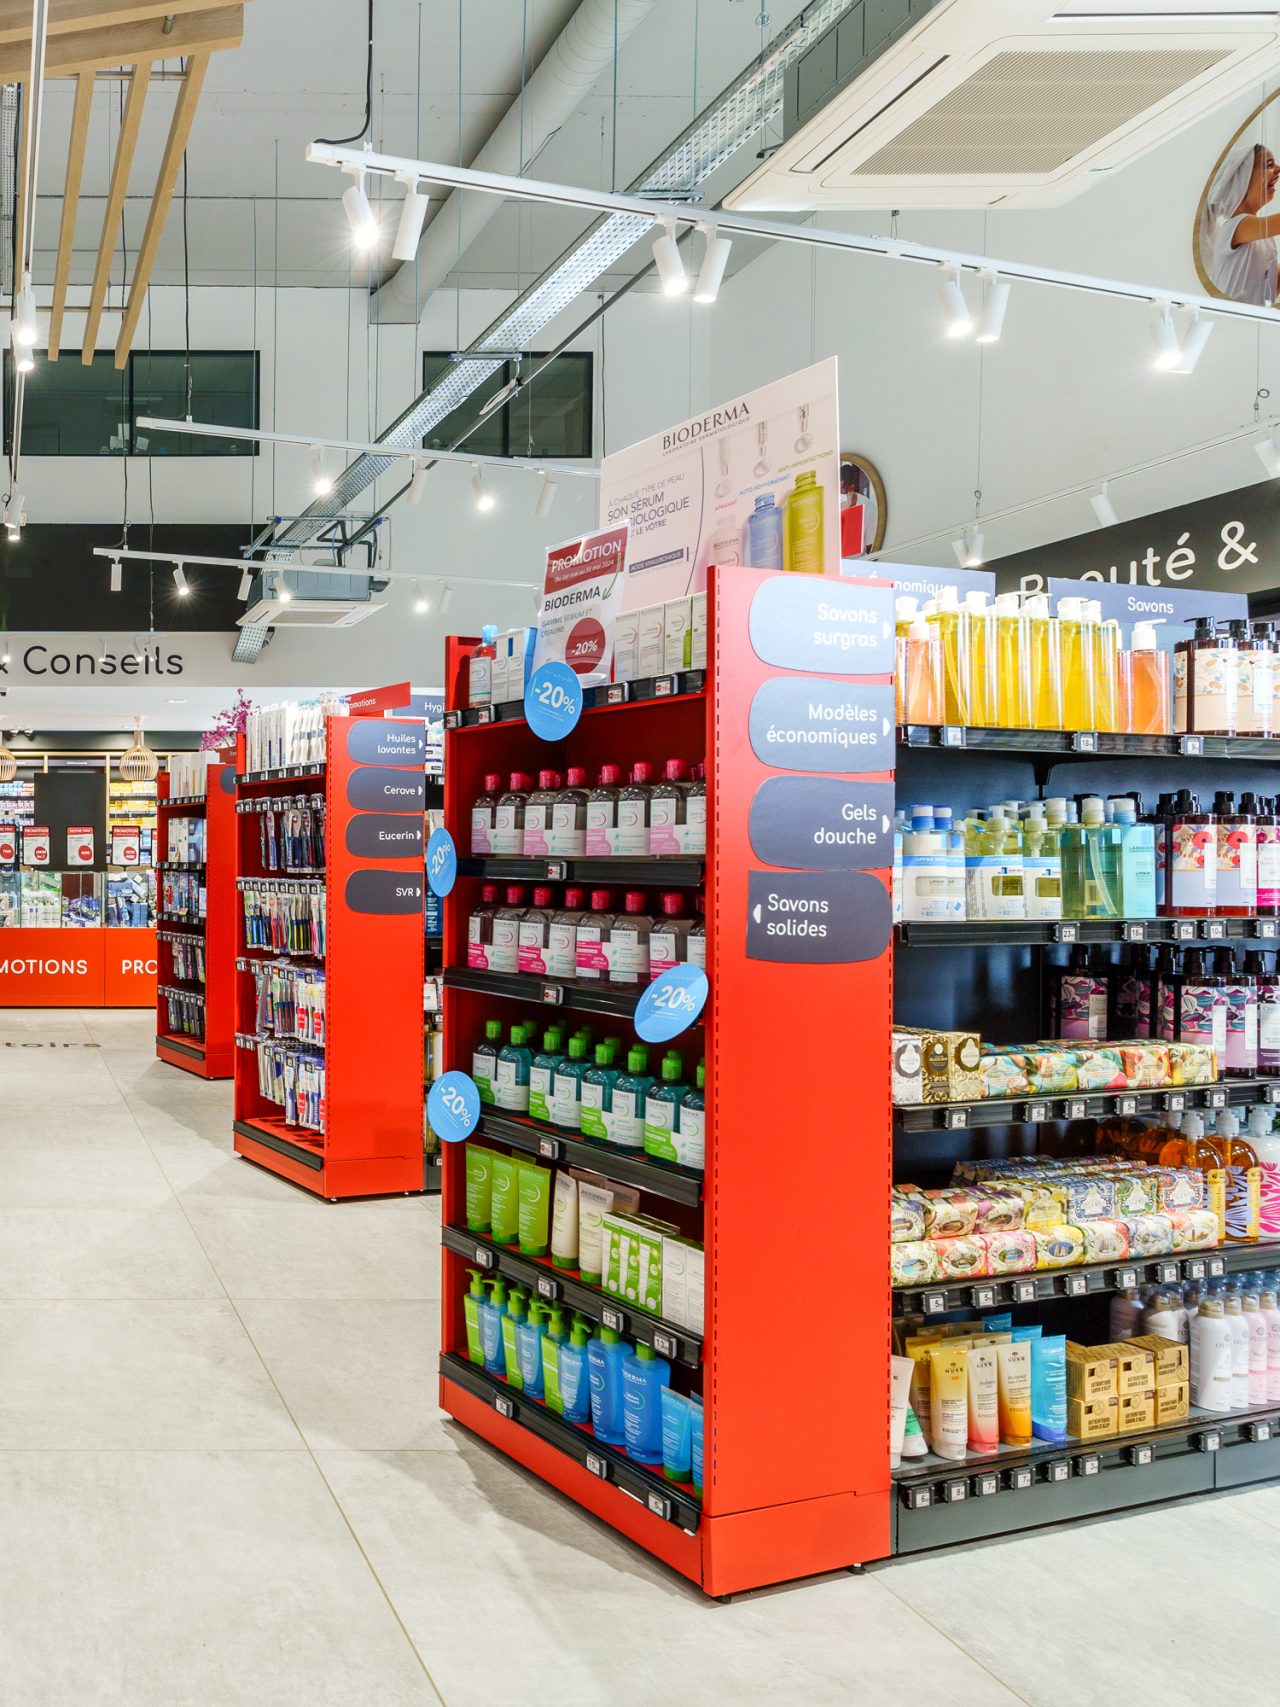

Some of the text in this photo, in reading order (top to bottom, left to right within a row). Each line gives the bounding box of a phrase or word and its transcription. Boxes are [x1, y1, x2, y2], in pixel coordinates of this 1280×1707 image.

[662, 401, 750, 450] BIODERMA
[657, 481, 666, 490] DE
[667, 472, 685, 487] PEAU
[607, 491, 665, 522] SON SÉRUM
[635, 518, 667, 536] LE VÔTRE
[551, 538, 622, 573] PROMOTION
[1019, 520, 1259, 609] Buté &
[544, 586, 601, 612] BIODERMA
[1127, 596, 1174, 615] Savons
[817, 602, 878, 624] Savons
[570, 638, 599, 656] -20%
[813, 630, 878, 651] surgras
[23, 645, 185, 677] Conseils
[346, 696, 377, 711] romotions
[534, 681, 576, 715] -20%
[808, 702, 878, 721] Modèles
[387, 733, 416, 743] Huiles
[766, 724, 878, 749] économiques
[377, 745, 416, 755] lavantes
[384, 785, 416, 795] Cerave
[841, 803, 877, 821] Gels
[379, 830, 414, 840] Eucerin
[813, 827, 877, 845] douche
[430, 840, 452, 875] -20%
[395, 887, 414, 897] SVR
[767, 893, 829, 914] Savons
[766, 919, 827, 937] solides
[650, 984, 696, 1013] -20%
[440, 1085, 471, 1128] -20%
[945, 1366, 964, 1374] NUXE
[976, 1361, 993, 1369] NUXE
